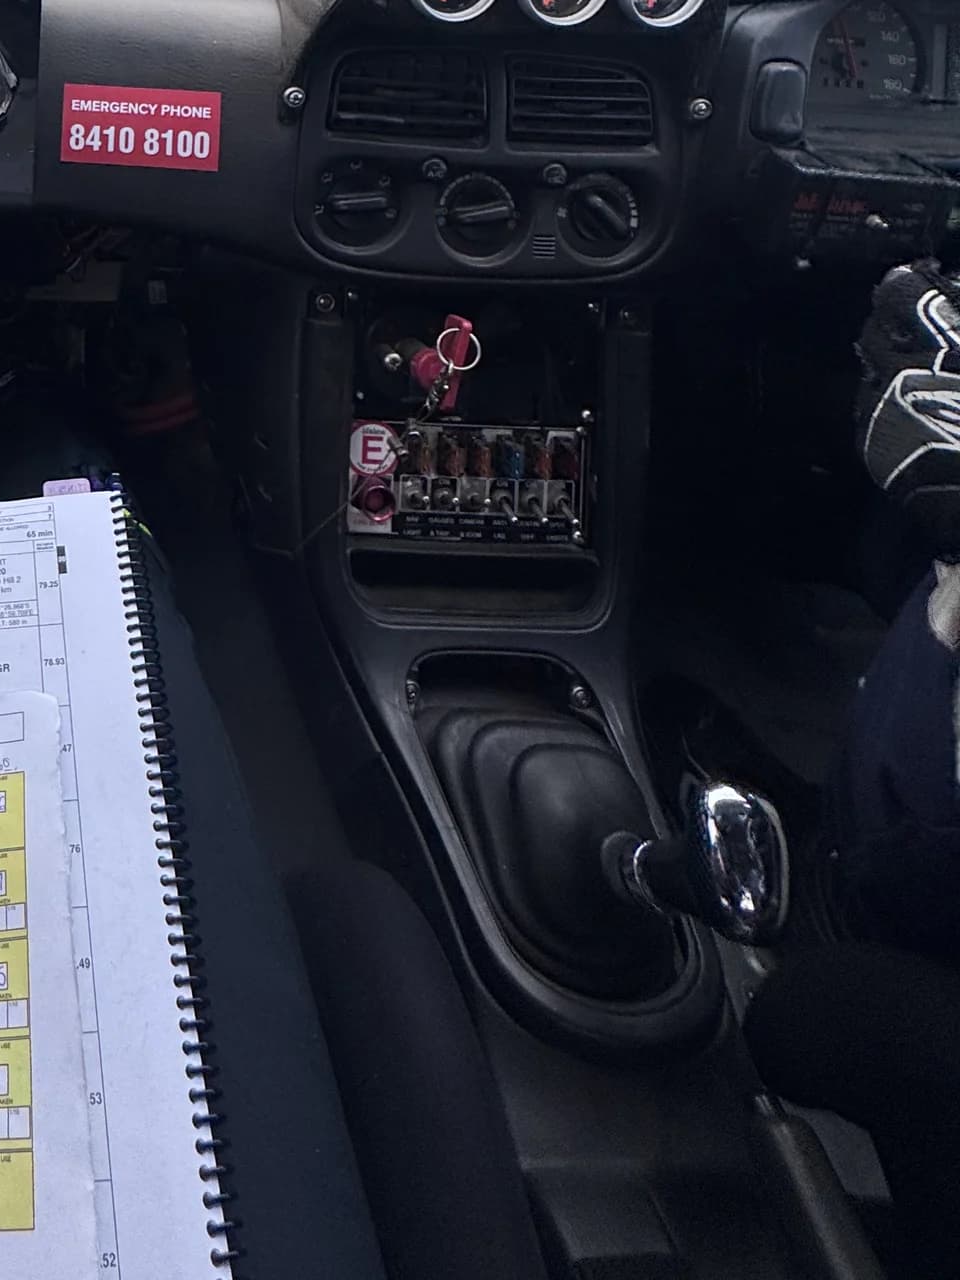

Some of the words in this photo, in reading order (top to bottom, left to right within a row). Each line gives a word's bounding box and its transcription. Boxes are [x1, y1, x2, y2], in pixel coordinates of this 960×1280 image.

[71, 99, 158, 116] EMERGENCY
[160, 104, 211, 119] PHONE
[69, 123, 135, 154] 8410
[143, 128, 210, 159] 8100
[361, 435, 384, 464] E
[26, 530, 36, 538] 65
[38, 530, 53, 538] min
[16, 576, 22, 584] 2
[38, 580, 59, 589] 79.25
[0, 586, 12, 594] km
[43, 656, 66, 668] 78.93
[89, 1093, 103, 1105] 53
